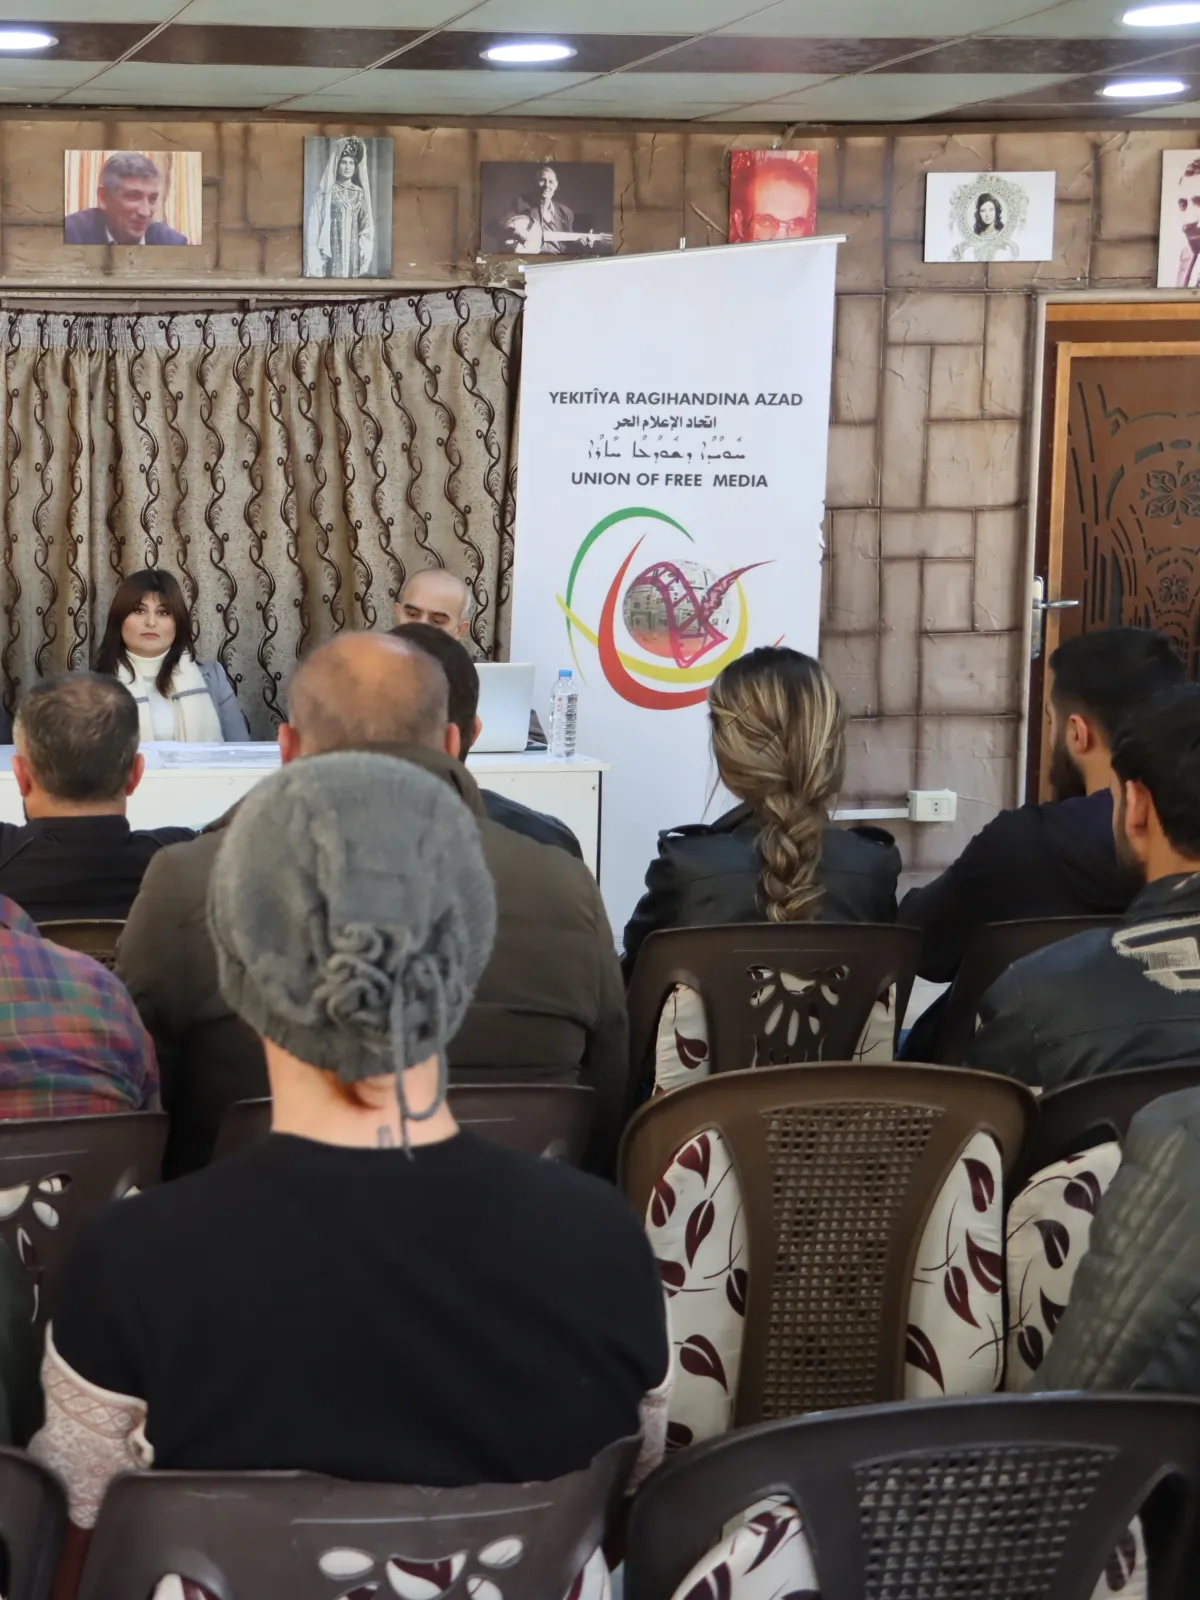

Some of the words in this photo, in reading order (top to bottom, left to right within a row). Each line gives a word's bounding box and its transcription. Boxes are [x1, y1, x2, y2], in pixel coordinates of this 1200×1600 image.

[548, 387, 621, 405] YEKITÎYA
[625, 391, 750, 406] RAGIHANDINA
[754, 392, 804, 407] AZAD
[612, 414, 640, 431] الحر
[571, 471, 631, 486] UNION
[635, 472, 660, 487] OF
[664, 473, 703, 487] FREE
[712, 473, 769, 488] MEDIA
